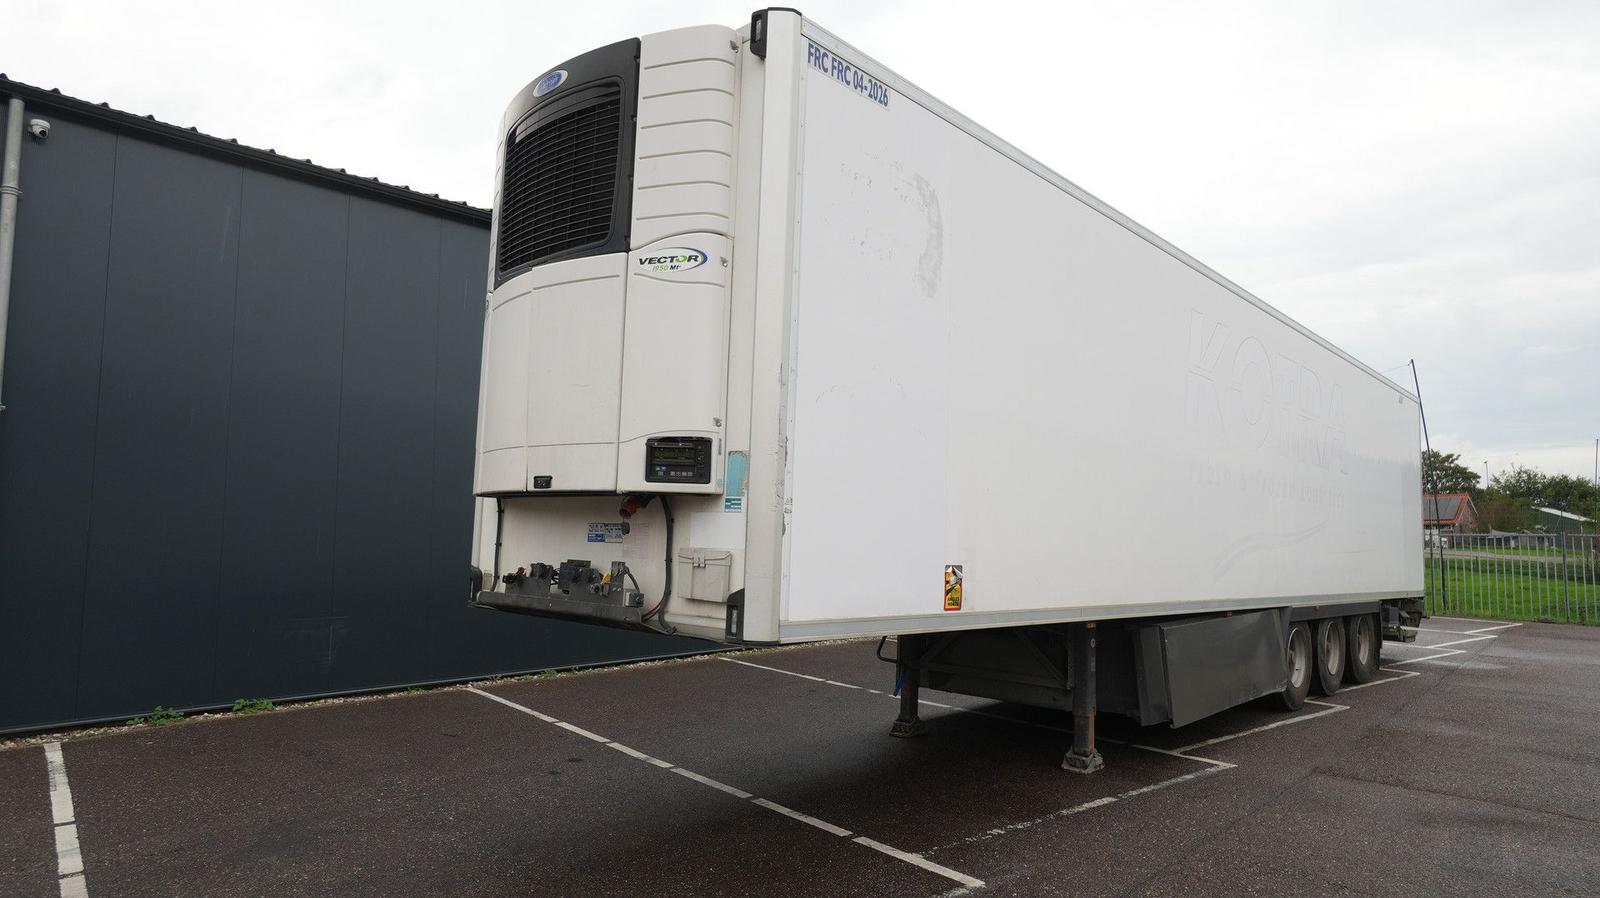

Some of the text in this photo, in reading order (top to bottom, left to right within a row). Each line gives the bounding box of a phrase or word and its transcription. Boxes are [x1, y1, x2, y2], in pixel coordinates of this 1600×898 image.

[807, 42, 889, 107] FRC FRC 04-2026
[638, 254, 699, 266] VECTOR
